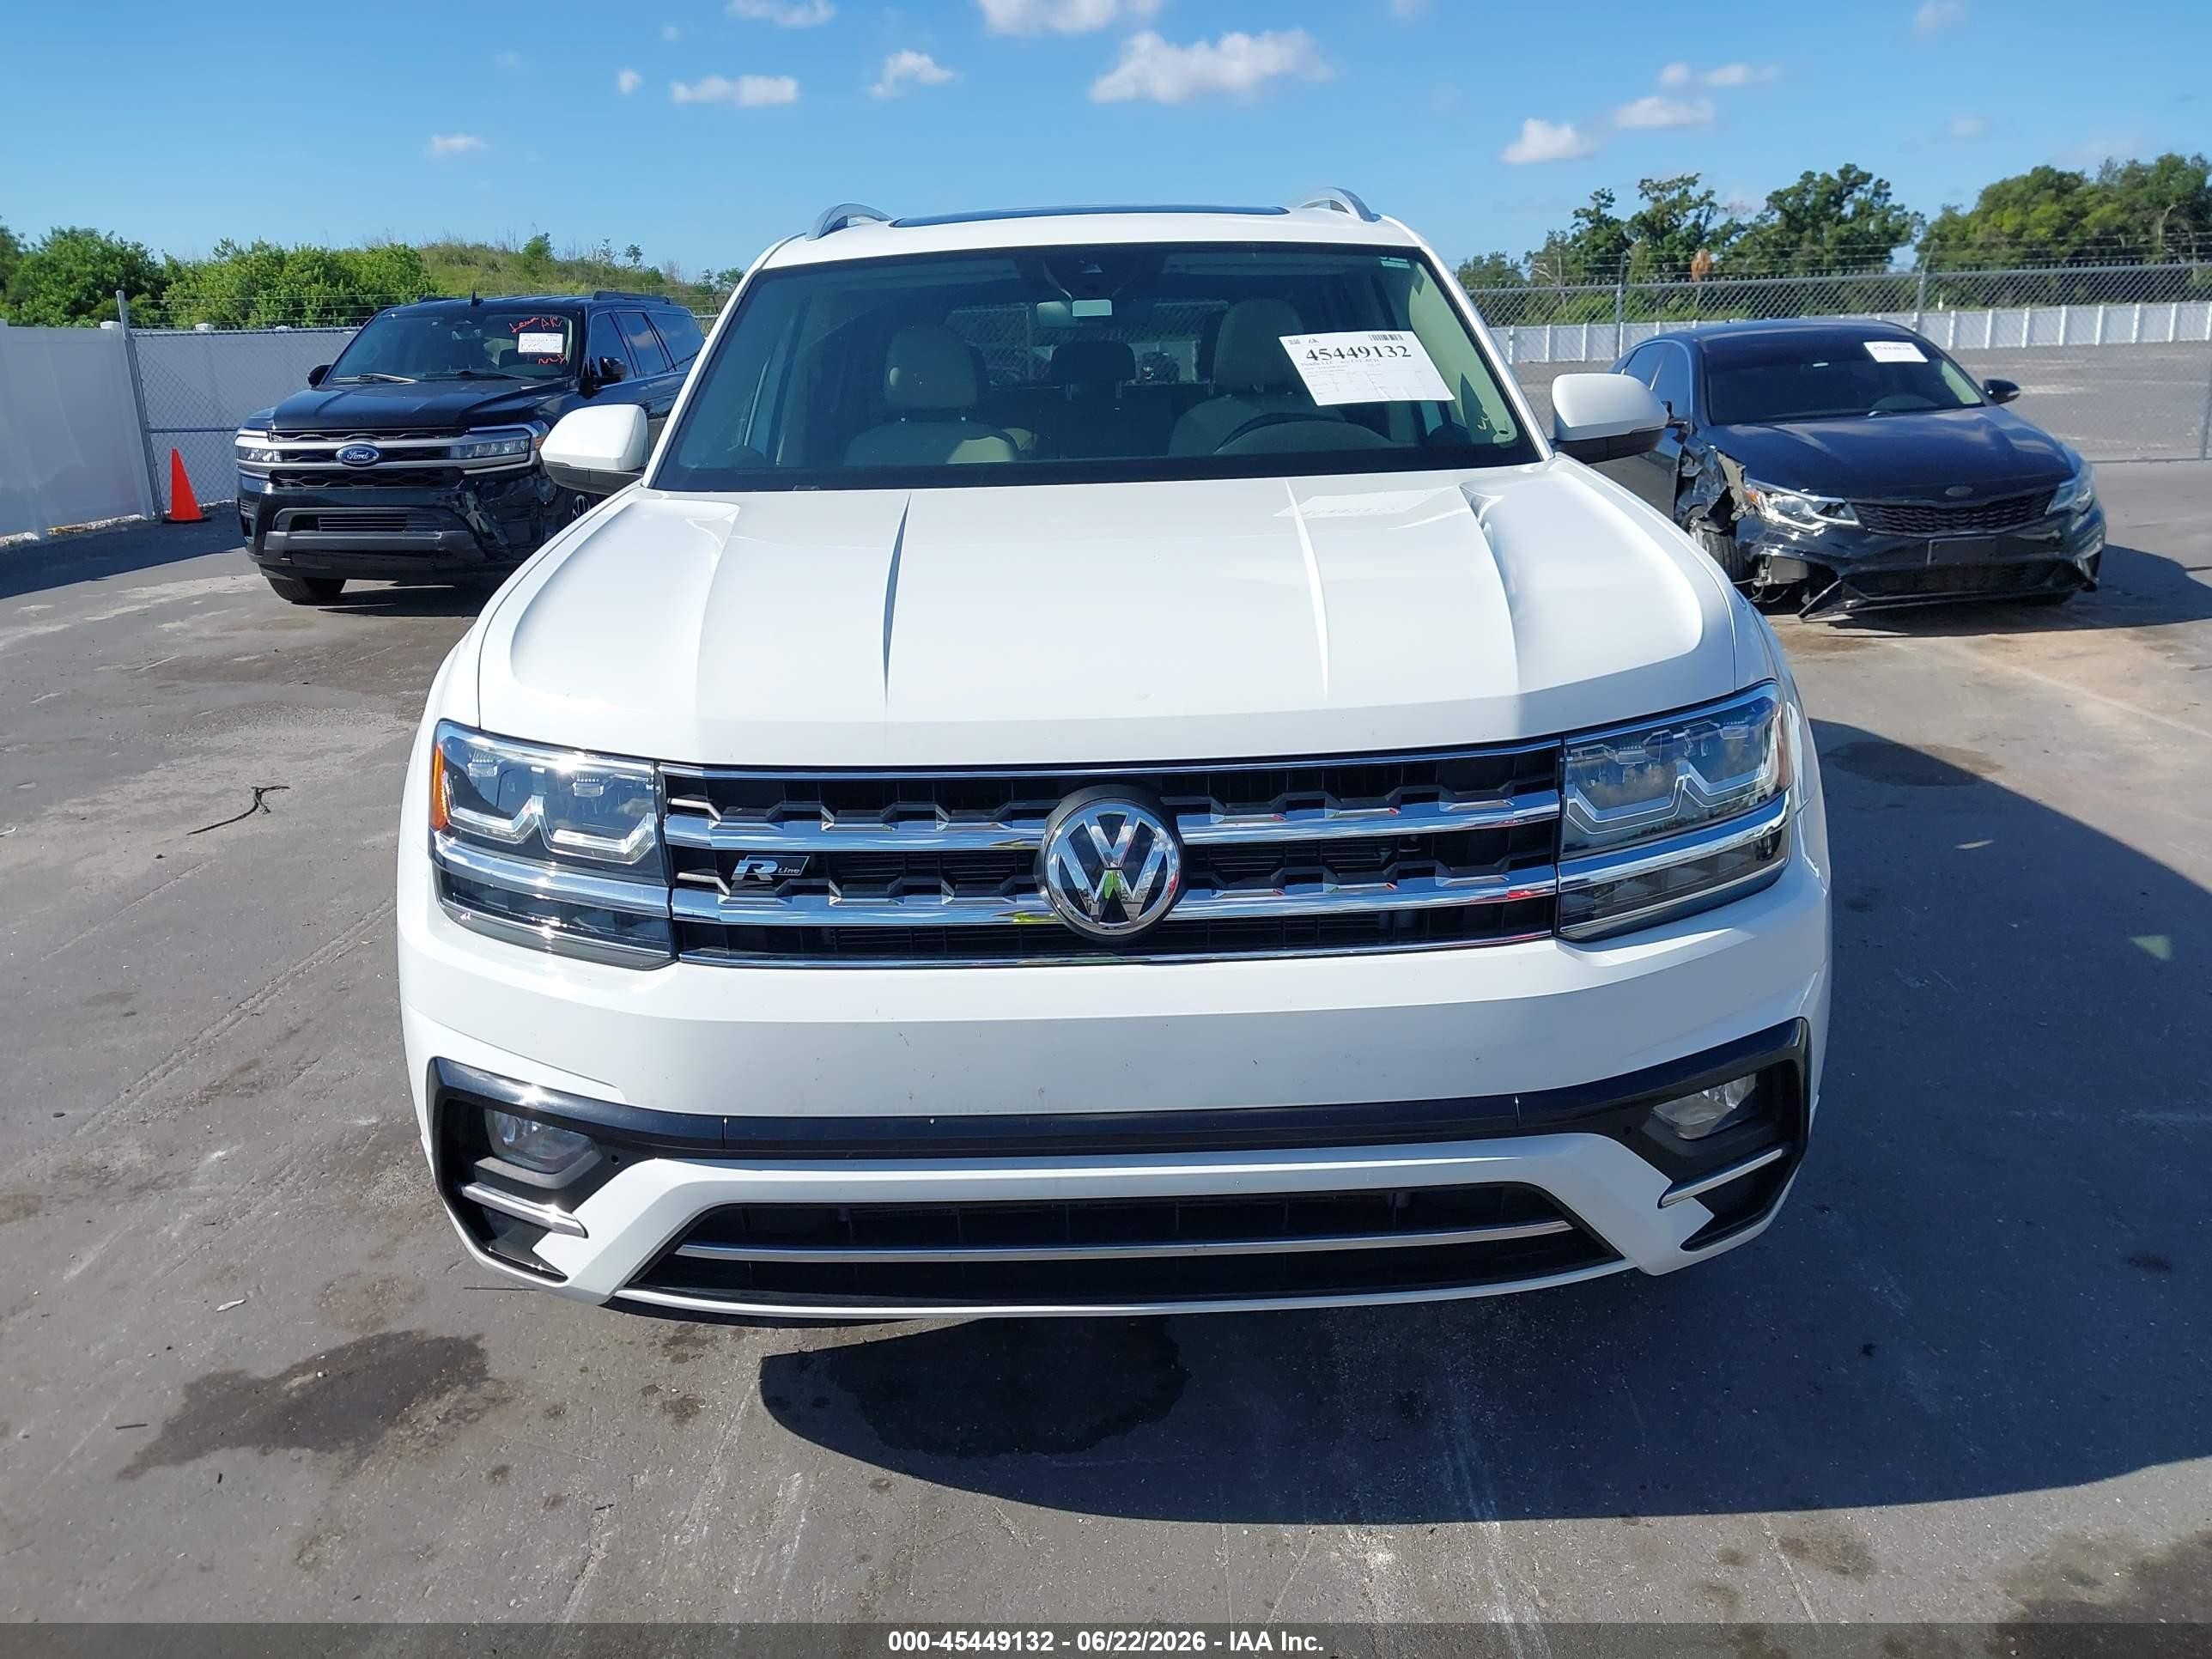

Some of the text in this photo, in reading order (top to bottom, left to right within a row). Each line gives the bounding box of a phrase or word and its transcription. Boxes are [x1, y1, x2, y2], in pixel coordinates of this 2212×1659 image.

[1306, 345, 1412, 362] 45449132
[347, 450, 369, 459] Ford
[731, 860, 778, 881] R
